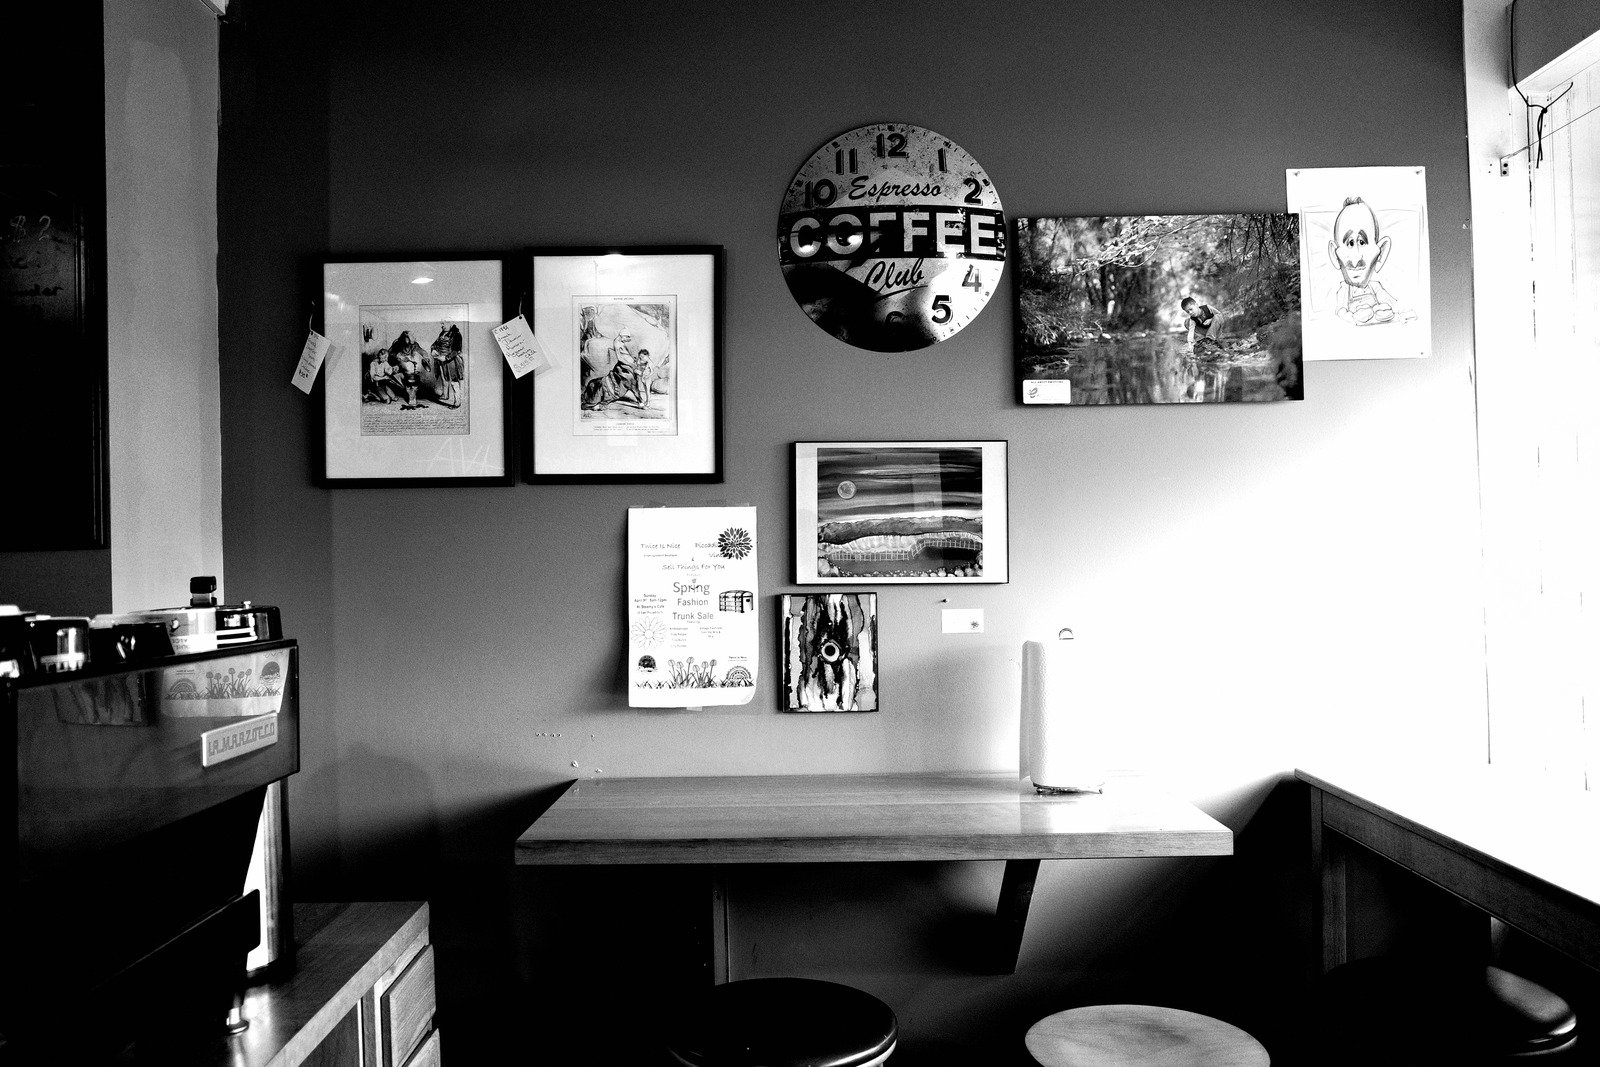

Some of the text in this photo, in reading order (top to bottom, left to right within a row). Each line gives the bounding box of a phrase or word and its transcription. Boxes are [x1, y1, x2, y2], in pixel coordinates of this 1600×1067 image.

[876, 133, 908, 158] 12
[835, 148, 858, 175] 11
[938, 147, 948, 173] 1
[804, 178, 837, 209] 10
[848, 175, 942, 202] Espresso
[963, 177, 983, 205] 2
[38, 214, 51, 241] 2
[789, 212, 997, 258] COFFEE
[865, 258, 924, 293] Club
[961, 264, 983, 293] 4
[931, 294, 954, 324] 5
[677, 563, 700, 572] Things
[712, 563, 726, 571] You
[673, 582, 711, 596] Spring
[677, 597, 709, 606] Fashion
[672, 612, 695, 620] Trunk
[697, 611, 714, 620] Sale
